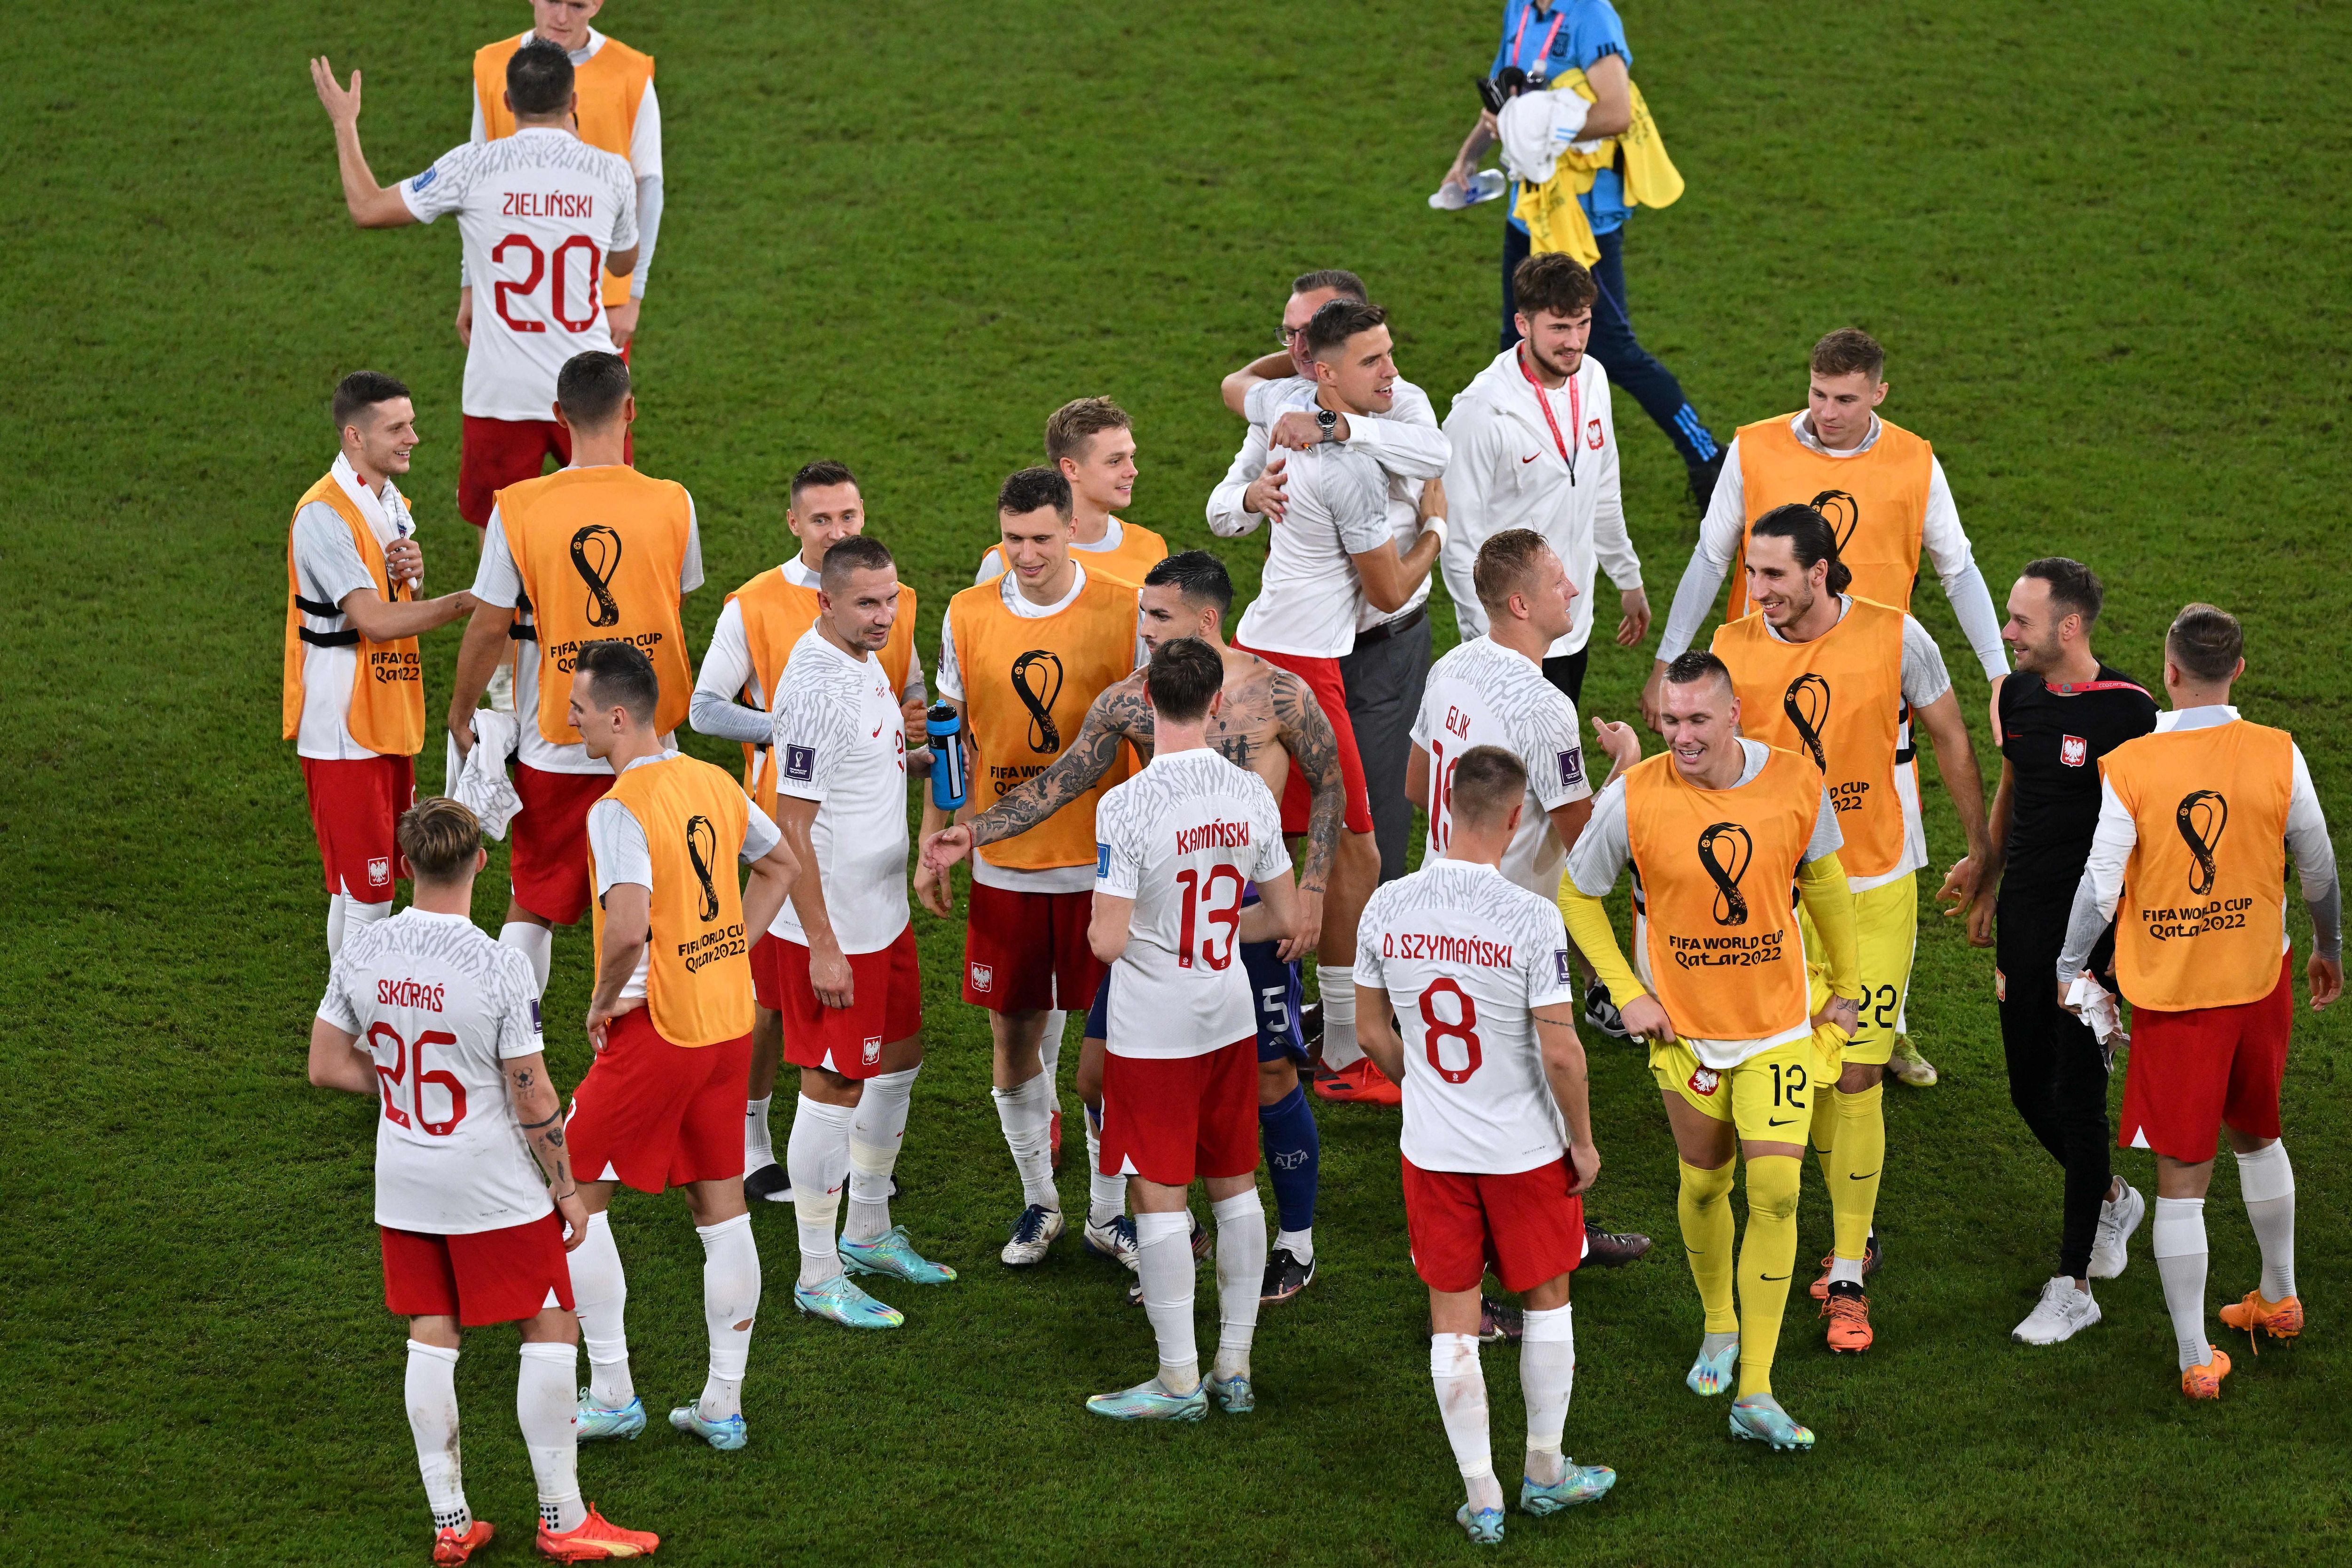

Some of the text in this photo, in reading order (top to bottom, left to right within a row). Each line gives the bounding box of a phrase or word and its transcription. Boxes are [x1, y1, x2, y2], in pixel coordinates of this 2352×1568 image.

[503, 189, 593, 218] ZIELIŃSKI
[492, 234, 601, 333] 20
[371, 652, 399, 665] FIFA
[404, 653, 420, 665] CU
[550, 640, 578, 658] FIFA
[636, 633, 663, 646] CUP
[1445, 705, 1471, 741] GLIK
[990, 766, 1019, 779] FIFA
[1840, 781, 1870, 794] CUP
[1176, 863, 1245, 971] 13
[2142, 908, 2178, 922] FIFA
[2224, 898, 2253, 911] CUP
[678, 922, 745, 956] FIFA ORLD CU
[685, 939, 745, 974] Qatar2022
[1383, 933, 1513, 968] D.SZYMAŃSKI
[1669, 929, 1783, 950] FIFA WORLD CUP
[1675, 947, 1781, 970] Qatar2022
[377, 977, 445, 1012] SKÓRAŚ
[1262, 986, 1290, 1033] 5
[1858, 984, 1897, 1028] 22
[1419, 977, 1482, 1084] 8
[367, 1021, 467, 1136] 26
[1769, 1064, 1807, 1109] 12
[1274, 1149, 1309, 1170] AFA
